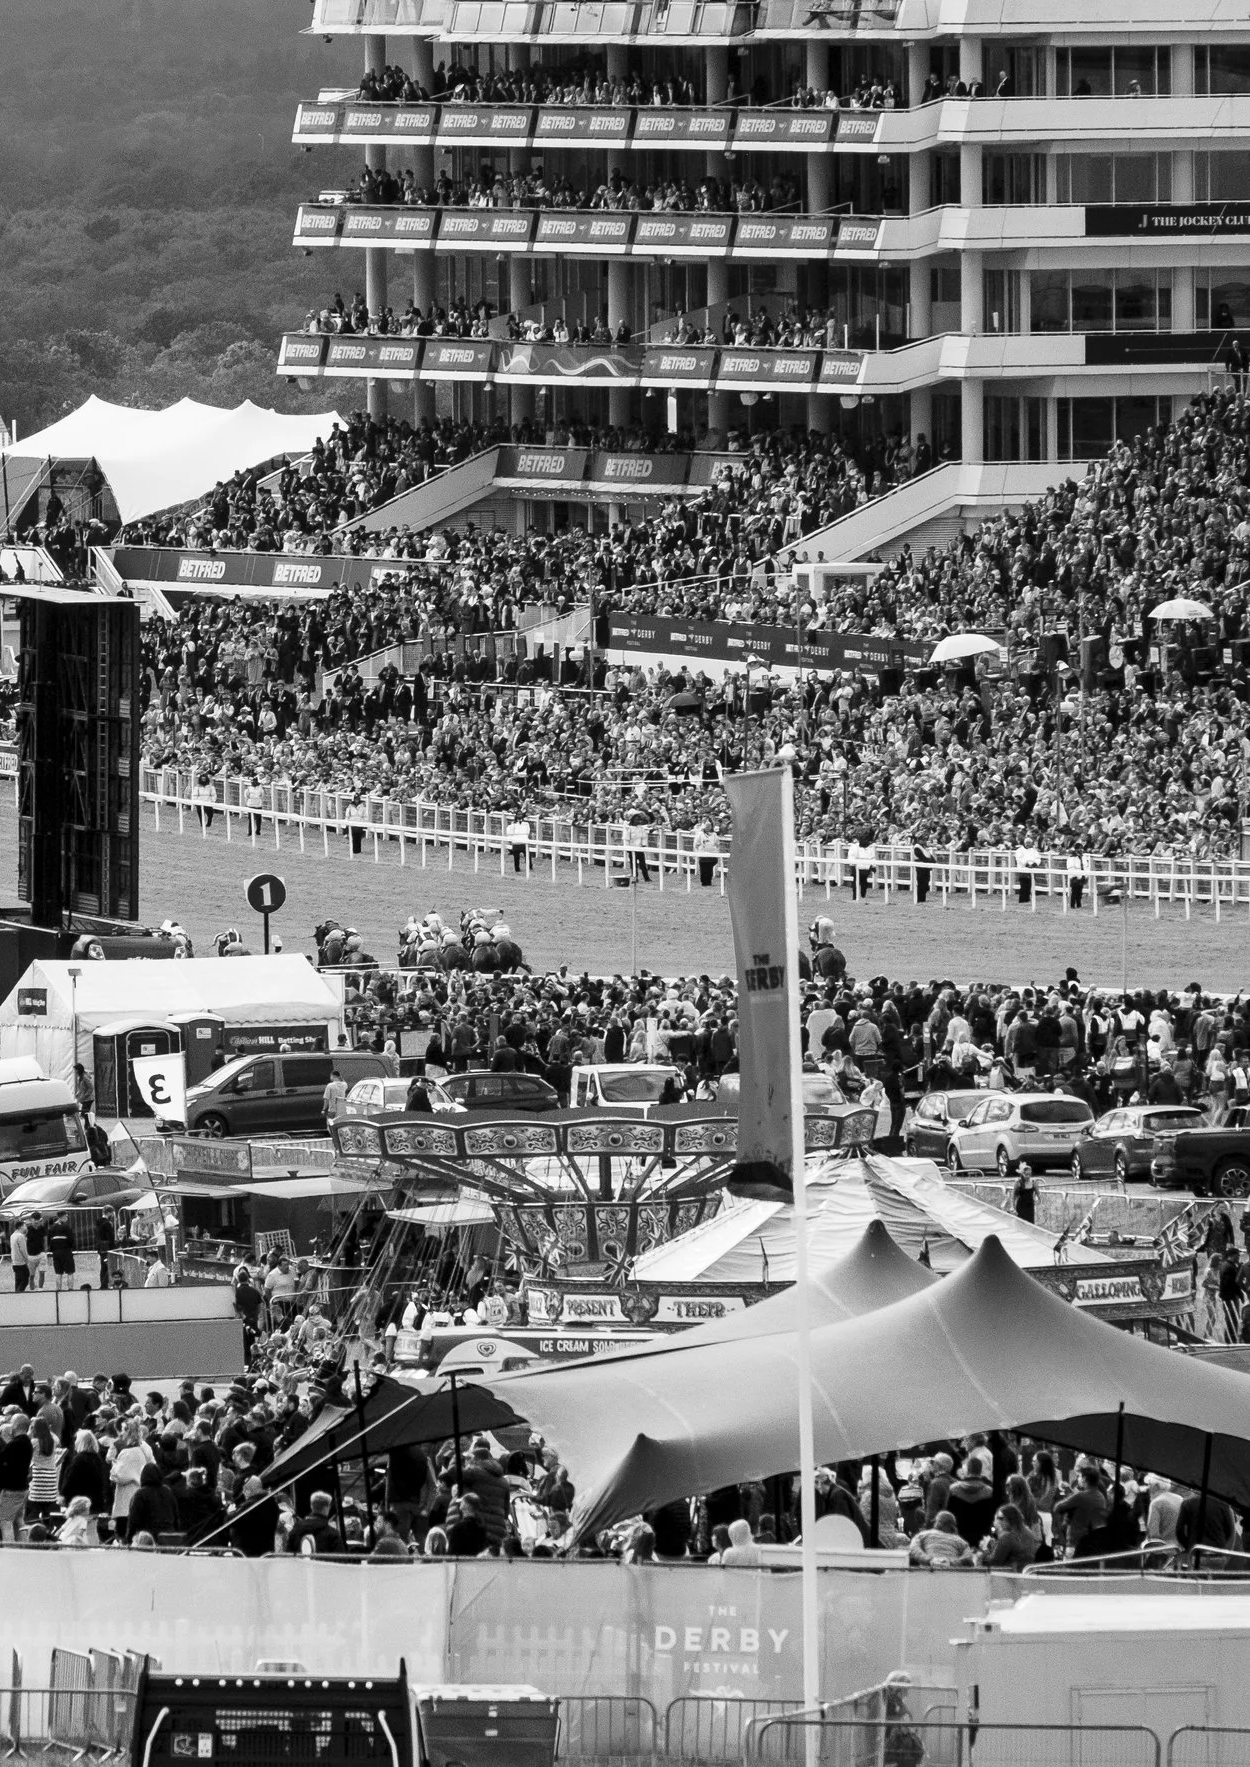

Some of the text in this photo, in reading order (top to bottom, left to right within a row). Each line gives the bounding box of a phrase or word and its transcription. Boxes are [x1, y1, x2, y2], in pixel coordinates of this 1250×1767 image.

[301, 112, 335, 126] BETFRED
[347, 113, 430, 127] BETFRED BETFRED
[443, 114, 527, 129] BETFRED BETFRED
[540, 115, 625, 131] BETFRED BETFRED
[639, 117, 725, 132] BETFRED BETFRED
[739, 118, 827, 134] BETFRED BETFRED
[840, 120, 876, 135] BETFRED
[301, 215, 335, 229] BETFRED
[347, 216, 430, 231] BETFRED BETFRED
[443, 217, 527, 233] BETFRED BETFRED
[541, 219, 625, 236] BETFRED BETFRED
[1152, 217, 1177, 226] THE
[1179, 216, 1224, 227] JOCKEY
[639, 222, 726, 238] BETFRED BETFRED
[740, 224, 827, 240] BETFRED BETFRED
[840, 226, 877, 241] BETFRED
[286, 344, 319, 358] BETFRED
[331, 346, 413, 361] BETFRED BETFRED
[439, 349, 474, 363] BETFRED
[660, 356, 696, 371] BETFRED
[723, 358, 810, 374] BETFRED BETFRED
[823, 360, 860, 376] BETFRED
[517, 455, 565, 473] BETFRED
[604, 458, 653, 476] BETFRED
[179, 559, 226, 579] BETFRED
[274, 564, 321, 583] BETFRED
[260, 882, 274, 907] 1
[745, 965, 785, 992] ERBY
[258, 1036, 275, 1044] HILL
[278, 1037, 305, 1045] Betting
[11, 1161, 78, 1180] FUN FAIR
[1076, 1280, 1142, 1301] GALLOPING
[566, 1299, 617, 1319] PRESENT
[673, 1301, 726, 1319] THEIR
[539, 1340, 554, 1352] ICE
[557, 1340, 589, 1353] CREAM
[708, 1605, 737, 1617] THE
[655, 1625, 789, 1654] DERBY
[683, 1661, 760, 1675] FESTIVAL
